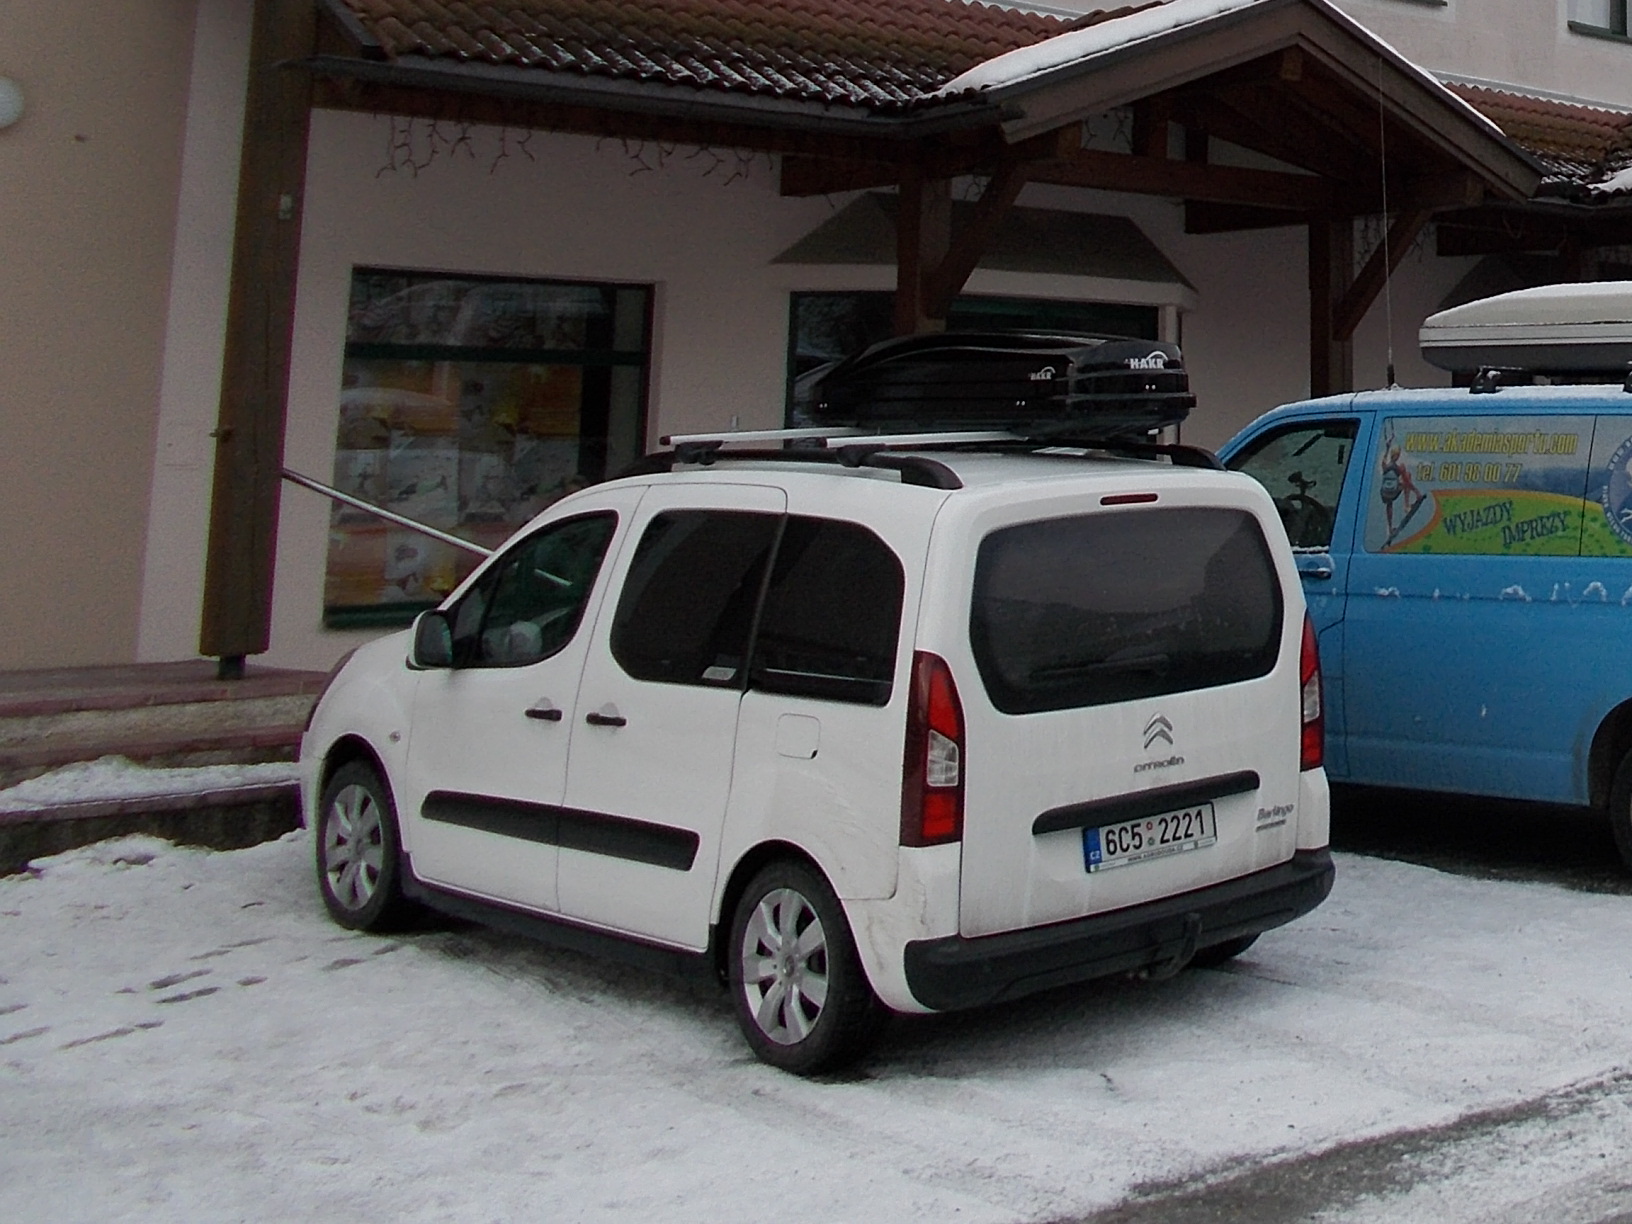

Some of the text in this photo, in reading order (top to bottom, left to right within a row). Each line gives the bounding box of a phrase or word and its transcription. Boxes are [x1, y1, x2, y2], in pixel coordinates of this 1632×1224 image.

[1130, 358, 1164, 370] HAKR
[1443, 500, 1513, 536] WYJAZDY
[1502, 510, 1569, 546] IMPREZY
[1105, 809, 1206, 856] 6C5 2221
